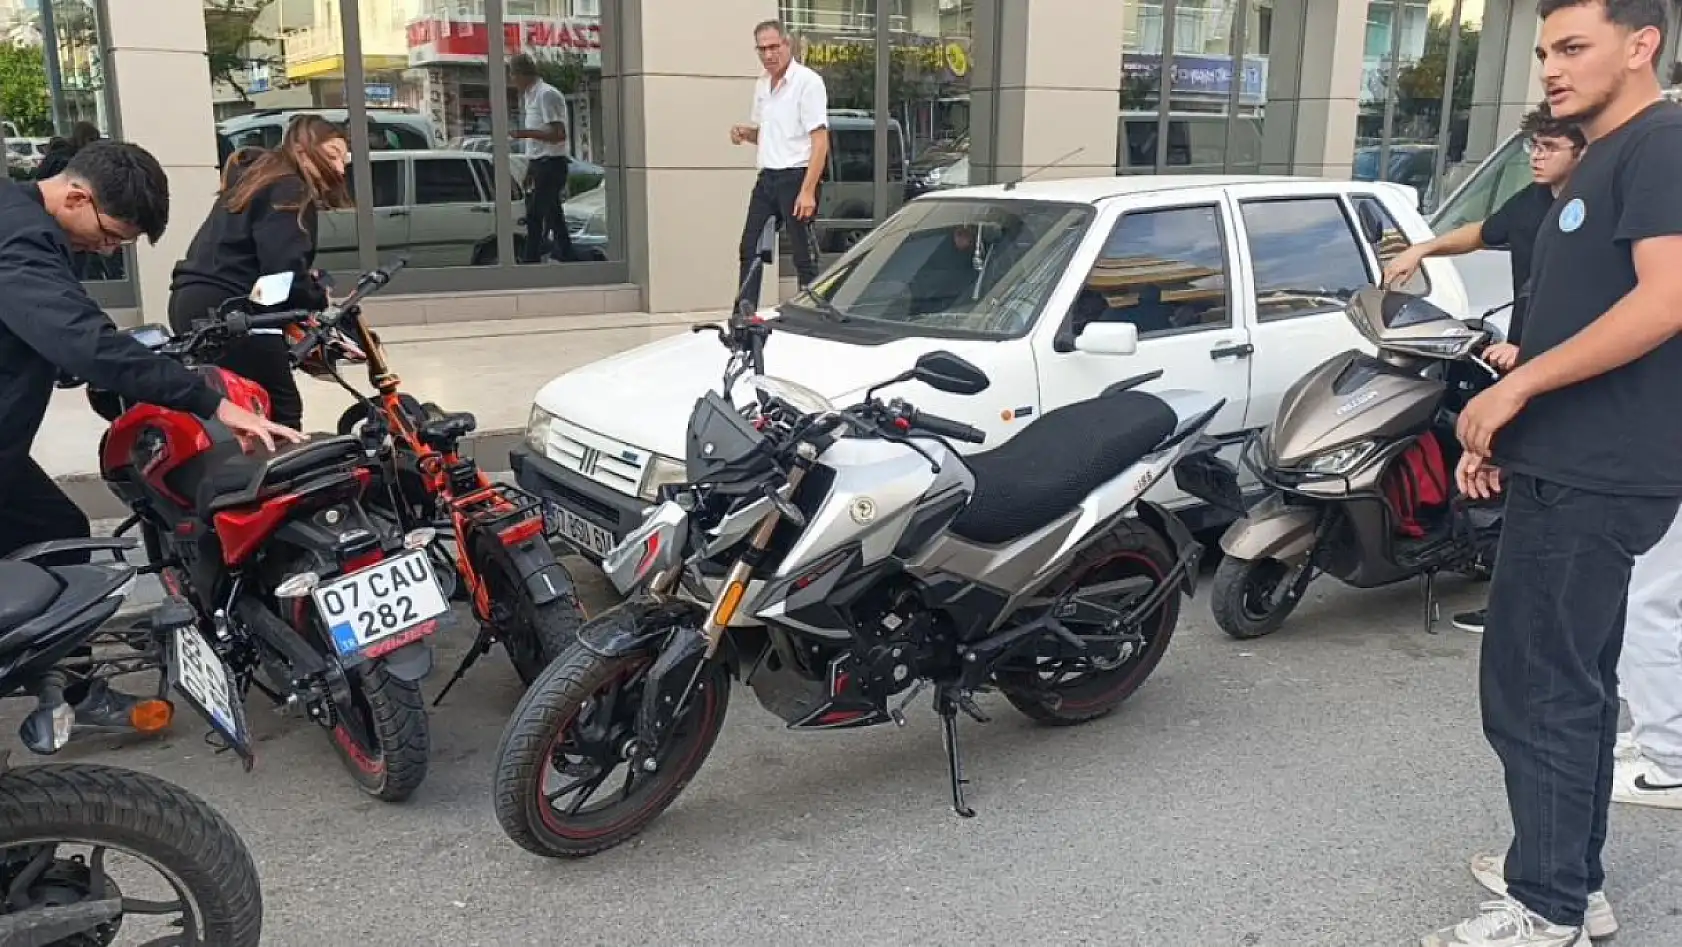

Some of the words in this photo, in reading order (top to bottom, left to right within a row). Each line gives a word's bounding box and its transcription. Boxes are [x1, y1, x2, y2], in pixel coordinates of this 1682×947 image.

[323, 582, 358, 616] 07
[368, 557, 428, 597] CAU
[358, 596, 419, 638] 282
